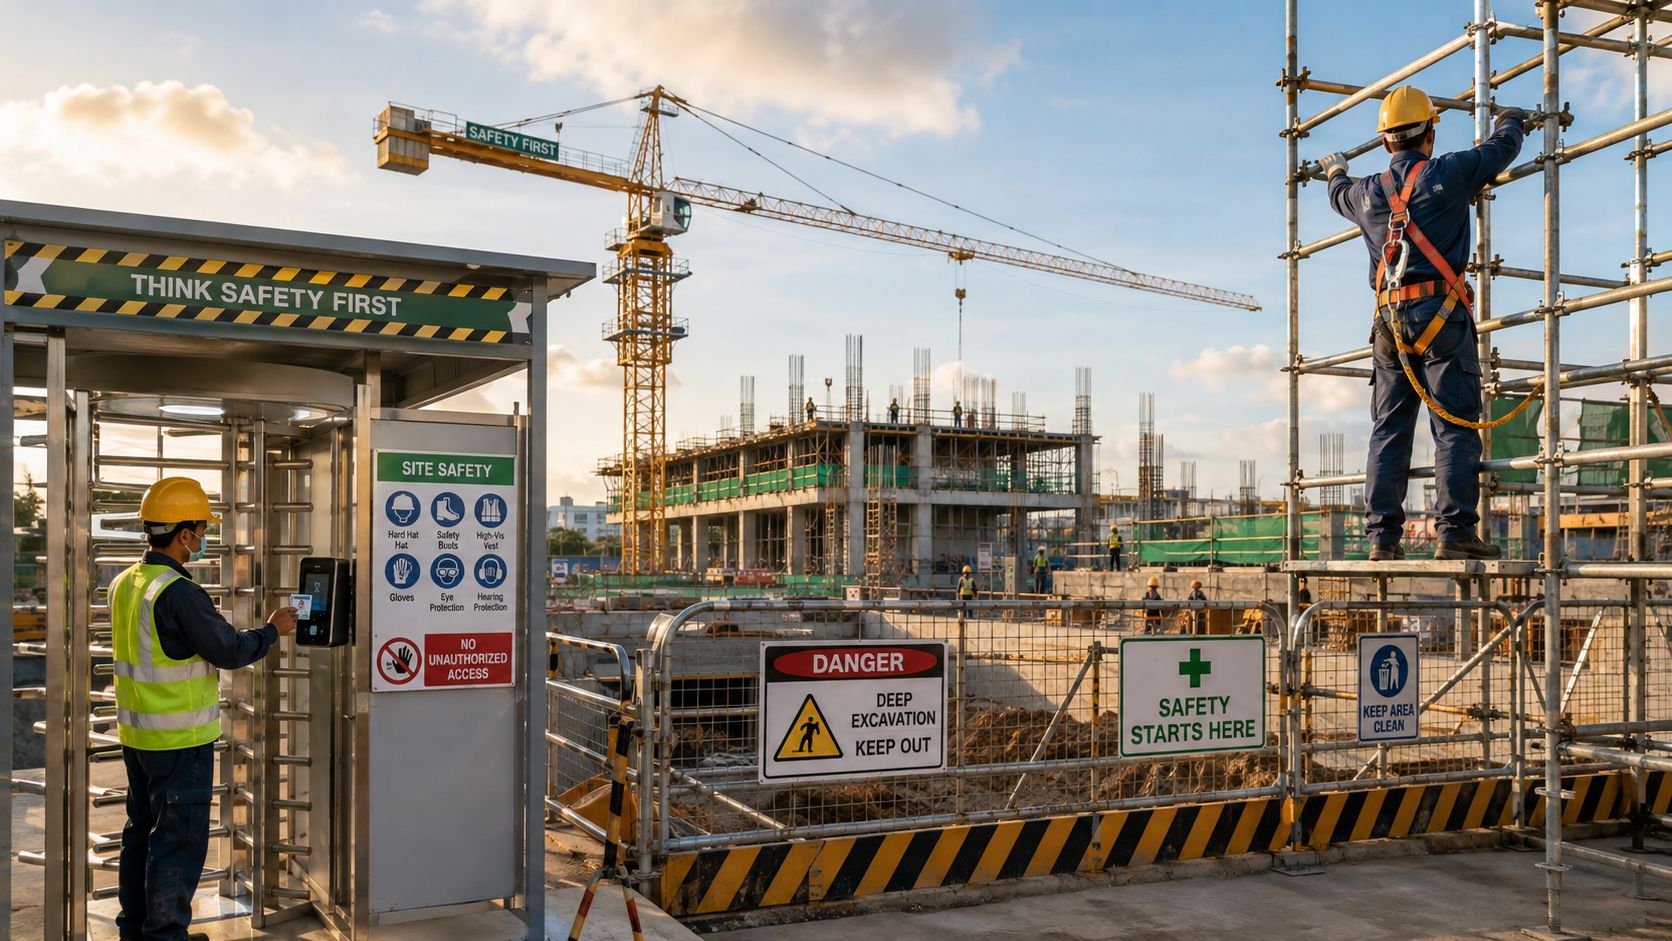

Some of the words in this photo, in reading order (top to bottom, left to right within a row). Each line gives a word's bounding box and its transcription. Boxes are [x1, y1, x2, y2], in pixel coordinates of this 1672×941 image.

[469, 126, 518, 148] SAFETY
[522, 138, 557, 156] FIRST
[131, 274, 212, 301] THINK
[221, 282, 324, 310] SAFETY
[333, 292, 402, 317] FIRST
[402, 461, 434, 476] SITE
[438, 462, 492, 478] SAFETY
[388, 530, 405, 539] Hard
[406, 530, 419, 539] Hat
[436, 530, 460, 541] Safety
[476, 531, 505, 541] High-Vis
[395, 540, 409, 549] Hat
[483, 541, 499, 550] Vest
[389, 592, 415, 602] Gloves
[440, 592, 454, 603] Eye
[477, 592, 504, 603] Hearing
[429, 603, 465, 612] Protection
[473, 603, 508, 612] Protection
[461, 638, 476, 650] NO
[428, 652, 508, 666] UNAUTHORIZED
[812, 652, 904, 674] DANGER
[447, 668, 489, 680] ACCESS
[877, 692, 913, 707] DEEP
[1158, 695, 1231, 718] SAFETY
[1363, 704, 1388, 719] KEEP
[1390, 703, 1415, 717] AREA
[851, 711, 936, 728] EXCAVATION
[1373, 719, 1405, 733] CLEAN
[1130, 721, 1203, 745] STARTS
[1209, 719, 1256, 740] HERE
[855, 738, 896, 757] KEEP
[900, 737, 931, 754] OUT
